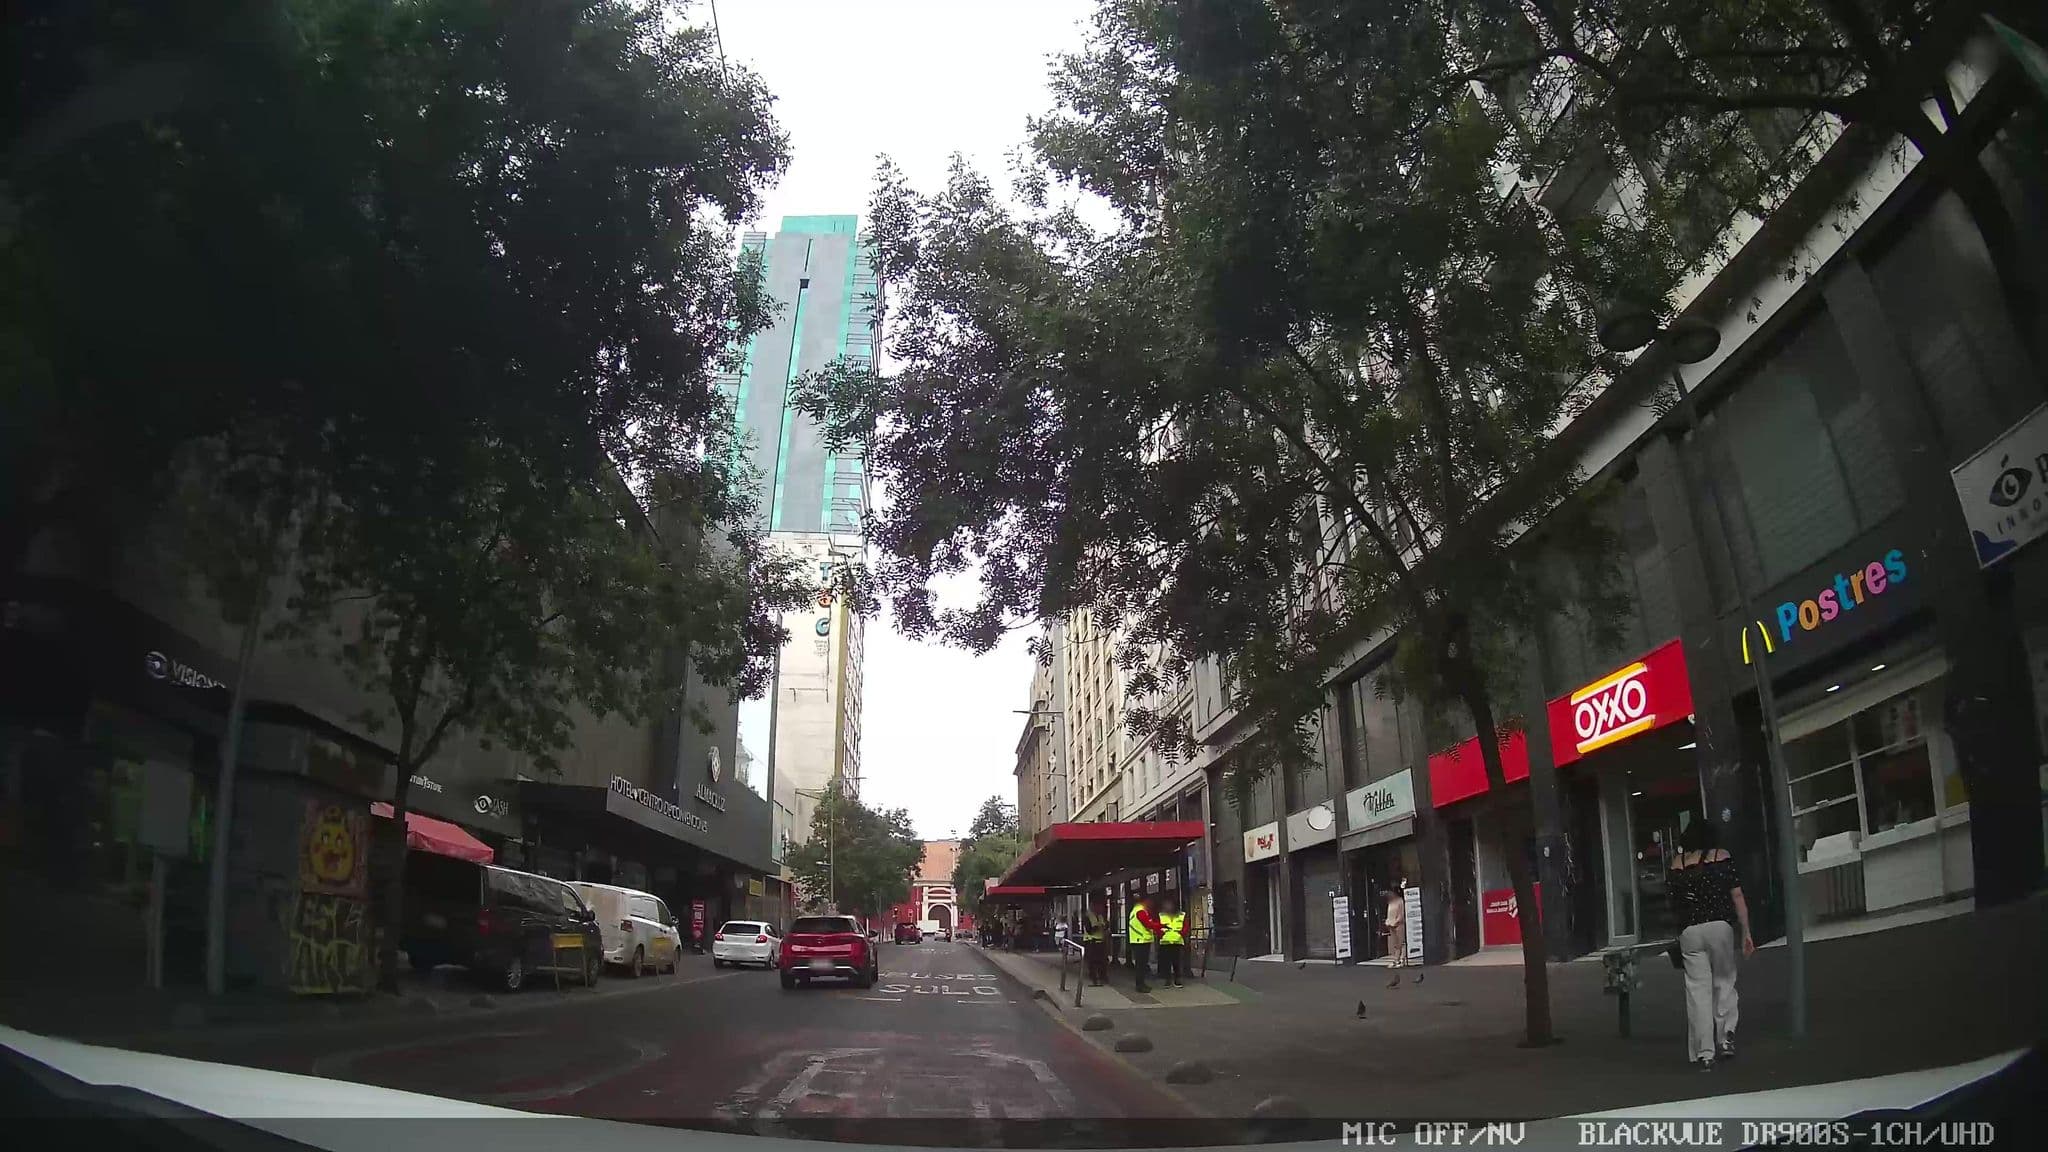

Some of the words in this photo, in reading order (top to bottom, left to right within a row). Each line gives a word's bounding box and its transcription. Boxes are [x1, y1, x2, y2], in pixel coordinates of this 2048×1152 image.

[1776, 550, 1907, 643] Postres
[1575, 679, 1647, 739] OXXO
[610, 774, 634, 800] HOTEL
